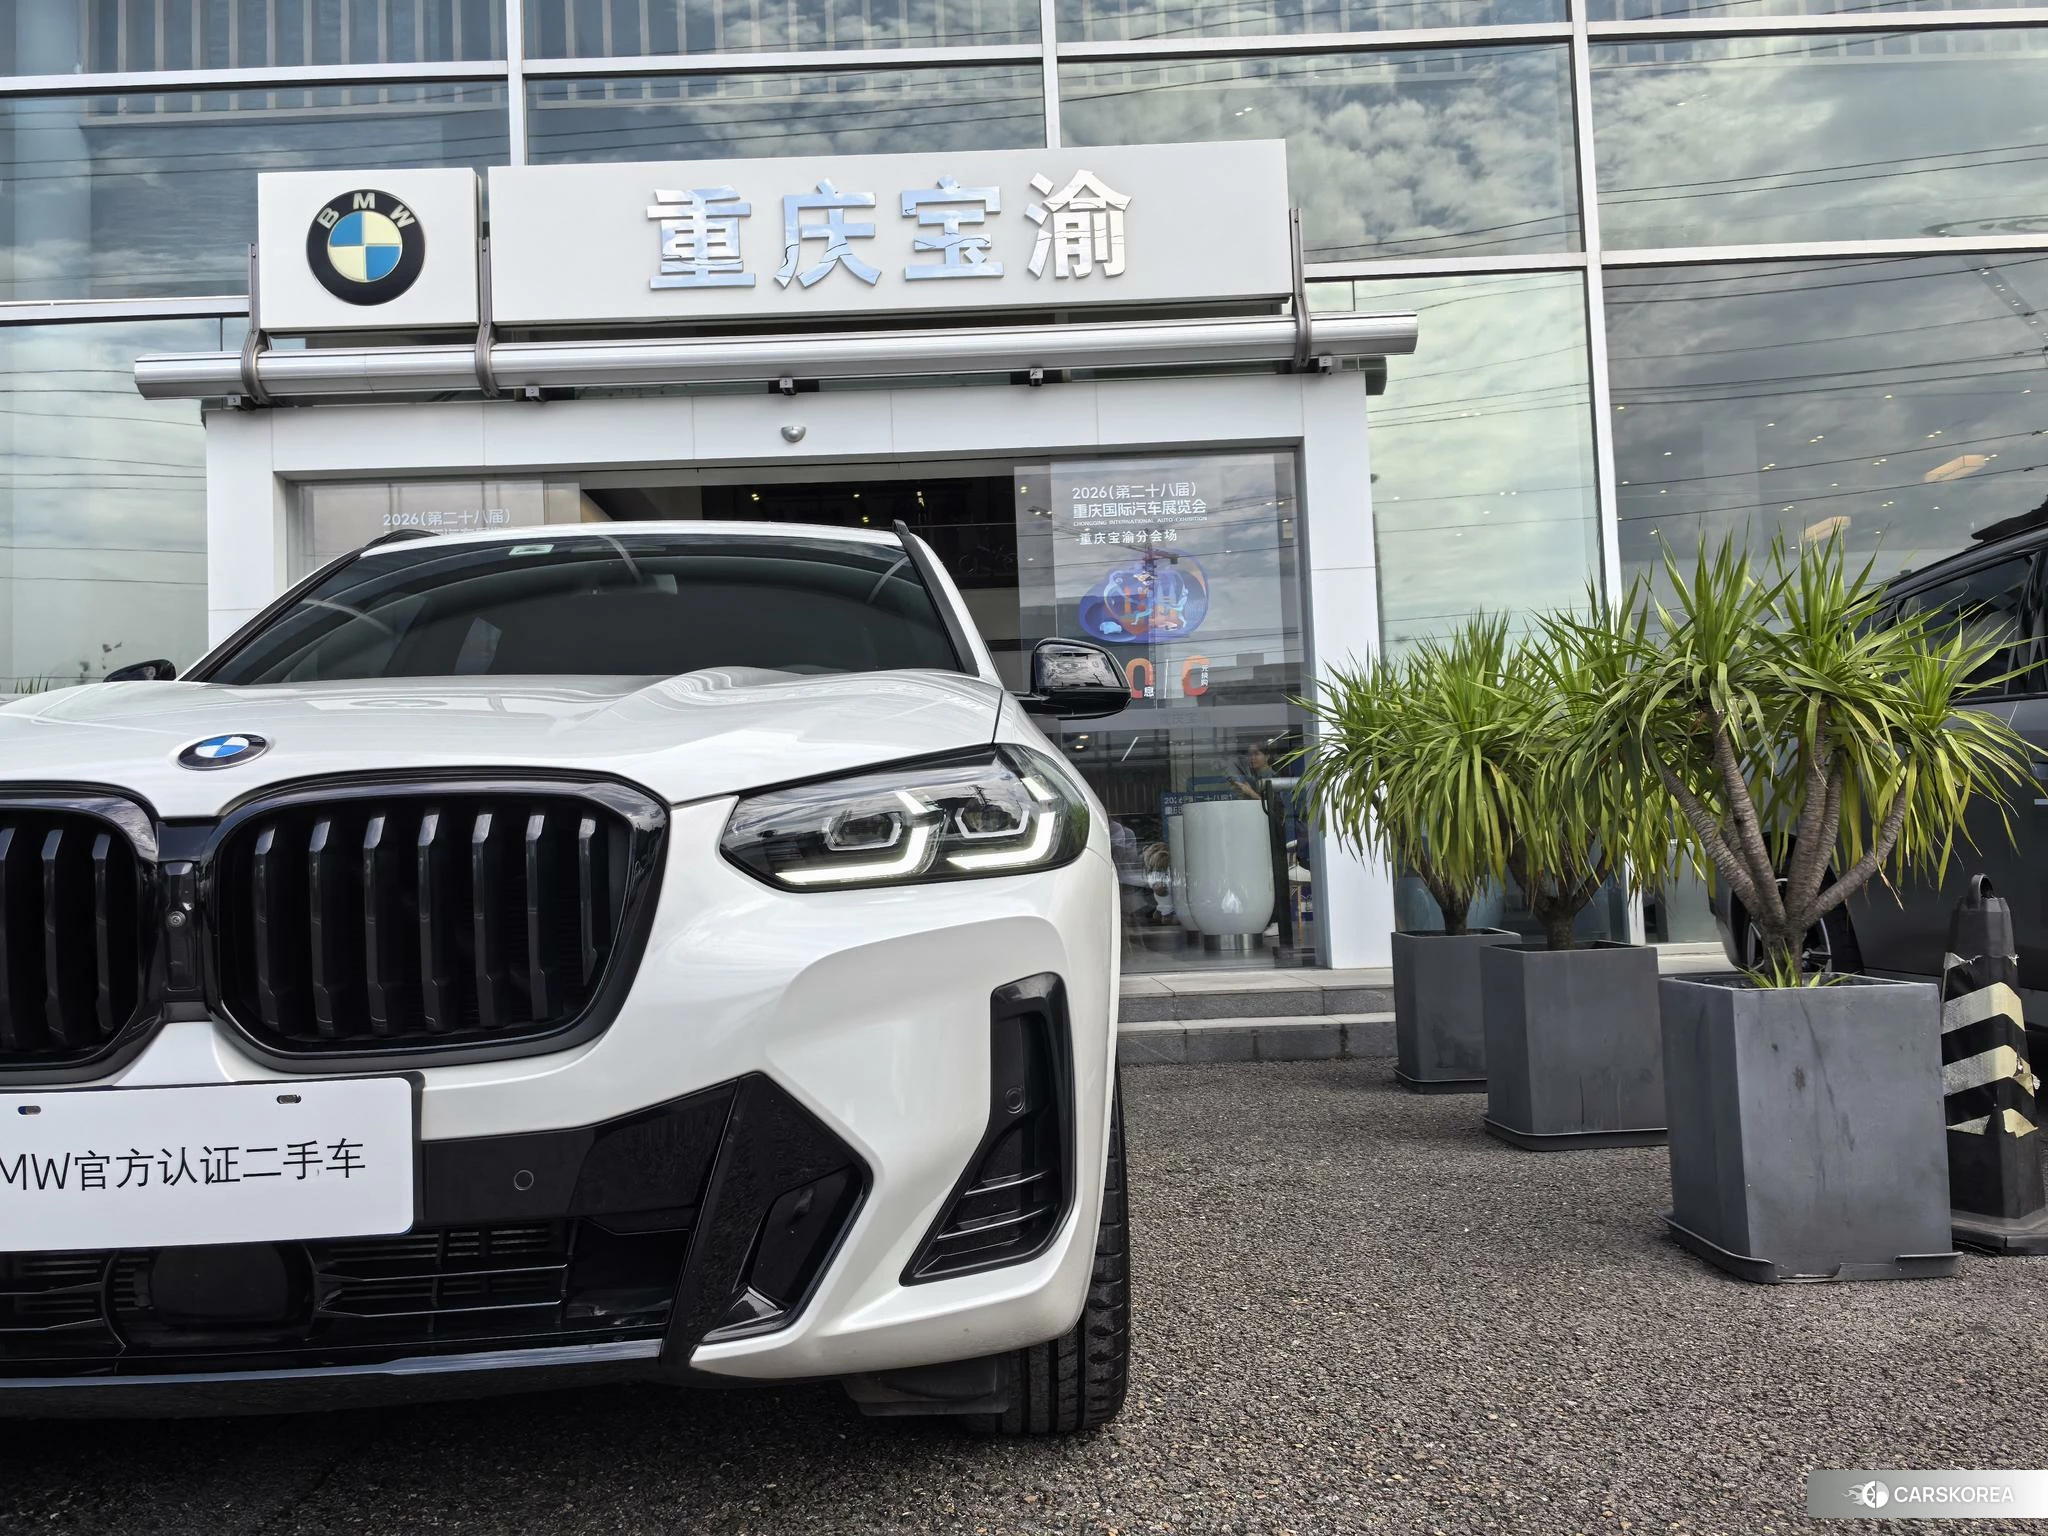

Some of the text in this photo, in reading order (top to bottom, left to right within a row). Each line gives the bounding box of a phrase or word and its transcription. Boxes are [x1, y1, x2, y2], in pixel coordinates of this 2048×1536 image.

[317, 192, 416, 230] BMW
[647, 168, 1132, 290] 重庆宝渝
[1072, 482, 1197, 500] 2026(第二十八届)
[383, 509, 511, 526] 2026(第二十八届)
[1073, 499, 1207, 519] 重庆国际汽车展览会
